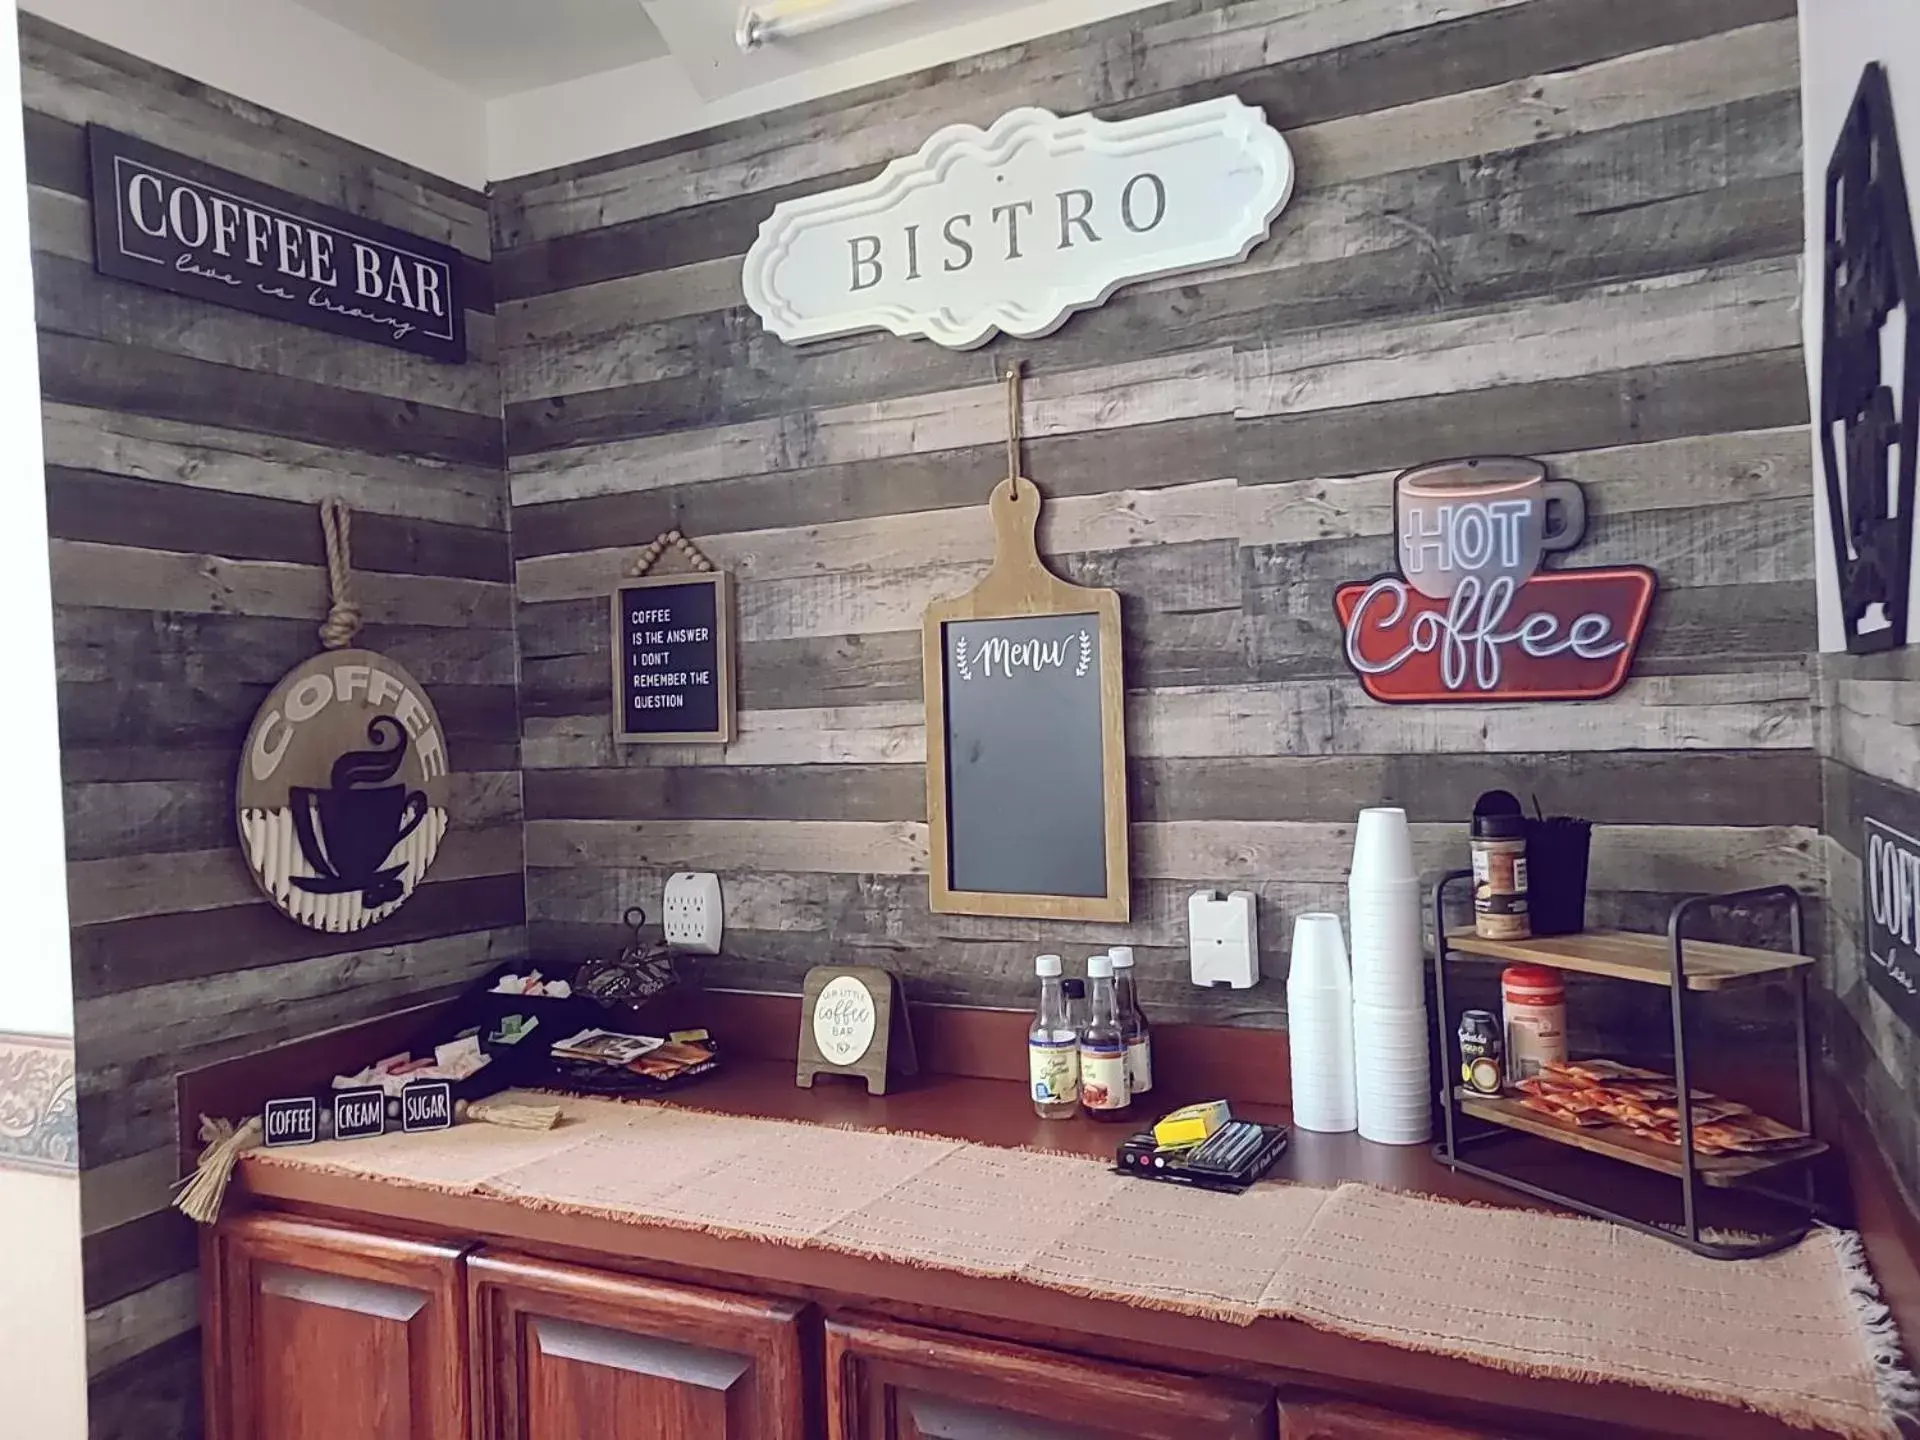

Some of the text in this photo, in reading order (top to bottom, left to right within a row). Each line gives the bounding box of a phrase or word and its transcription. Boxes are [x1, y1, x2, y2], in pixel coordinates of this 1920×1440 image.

[128, 173, 444, 316] COFFEE BAR
[847, 173, 1166, 292] BISTRO
[175, 253, 242, 286] love
[1403, 499, 1532, 573] HOT
[632, 609, 671, 624] COFFEE
[632, 628, 710, 646] IS THE ANSWER
[1346, 576, 1629, 690] Coffee
[633, 652, 670, 667] I DON'T
[972, 634, 1075, 678] Menu
[634, 671, 710, 688] REMEMBER THE
[634, 694, 683, 709] QUESTION
[251, 665, 446, 782] COFFEE
[339, 1101, 380, 1129] CREAM
[407, 1093, 447, 1121] SUGAR
[269, 1108, 312, 1135] COFFEE
